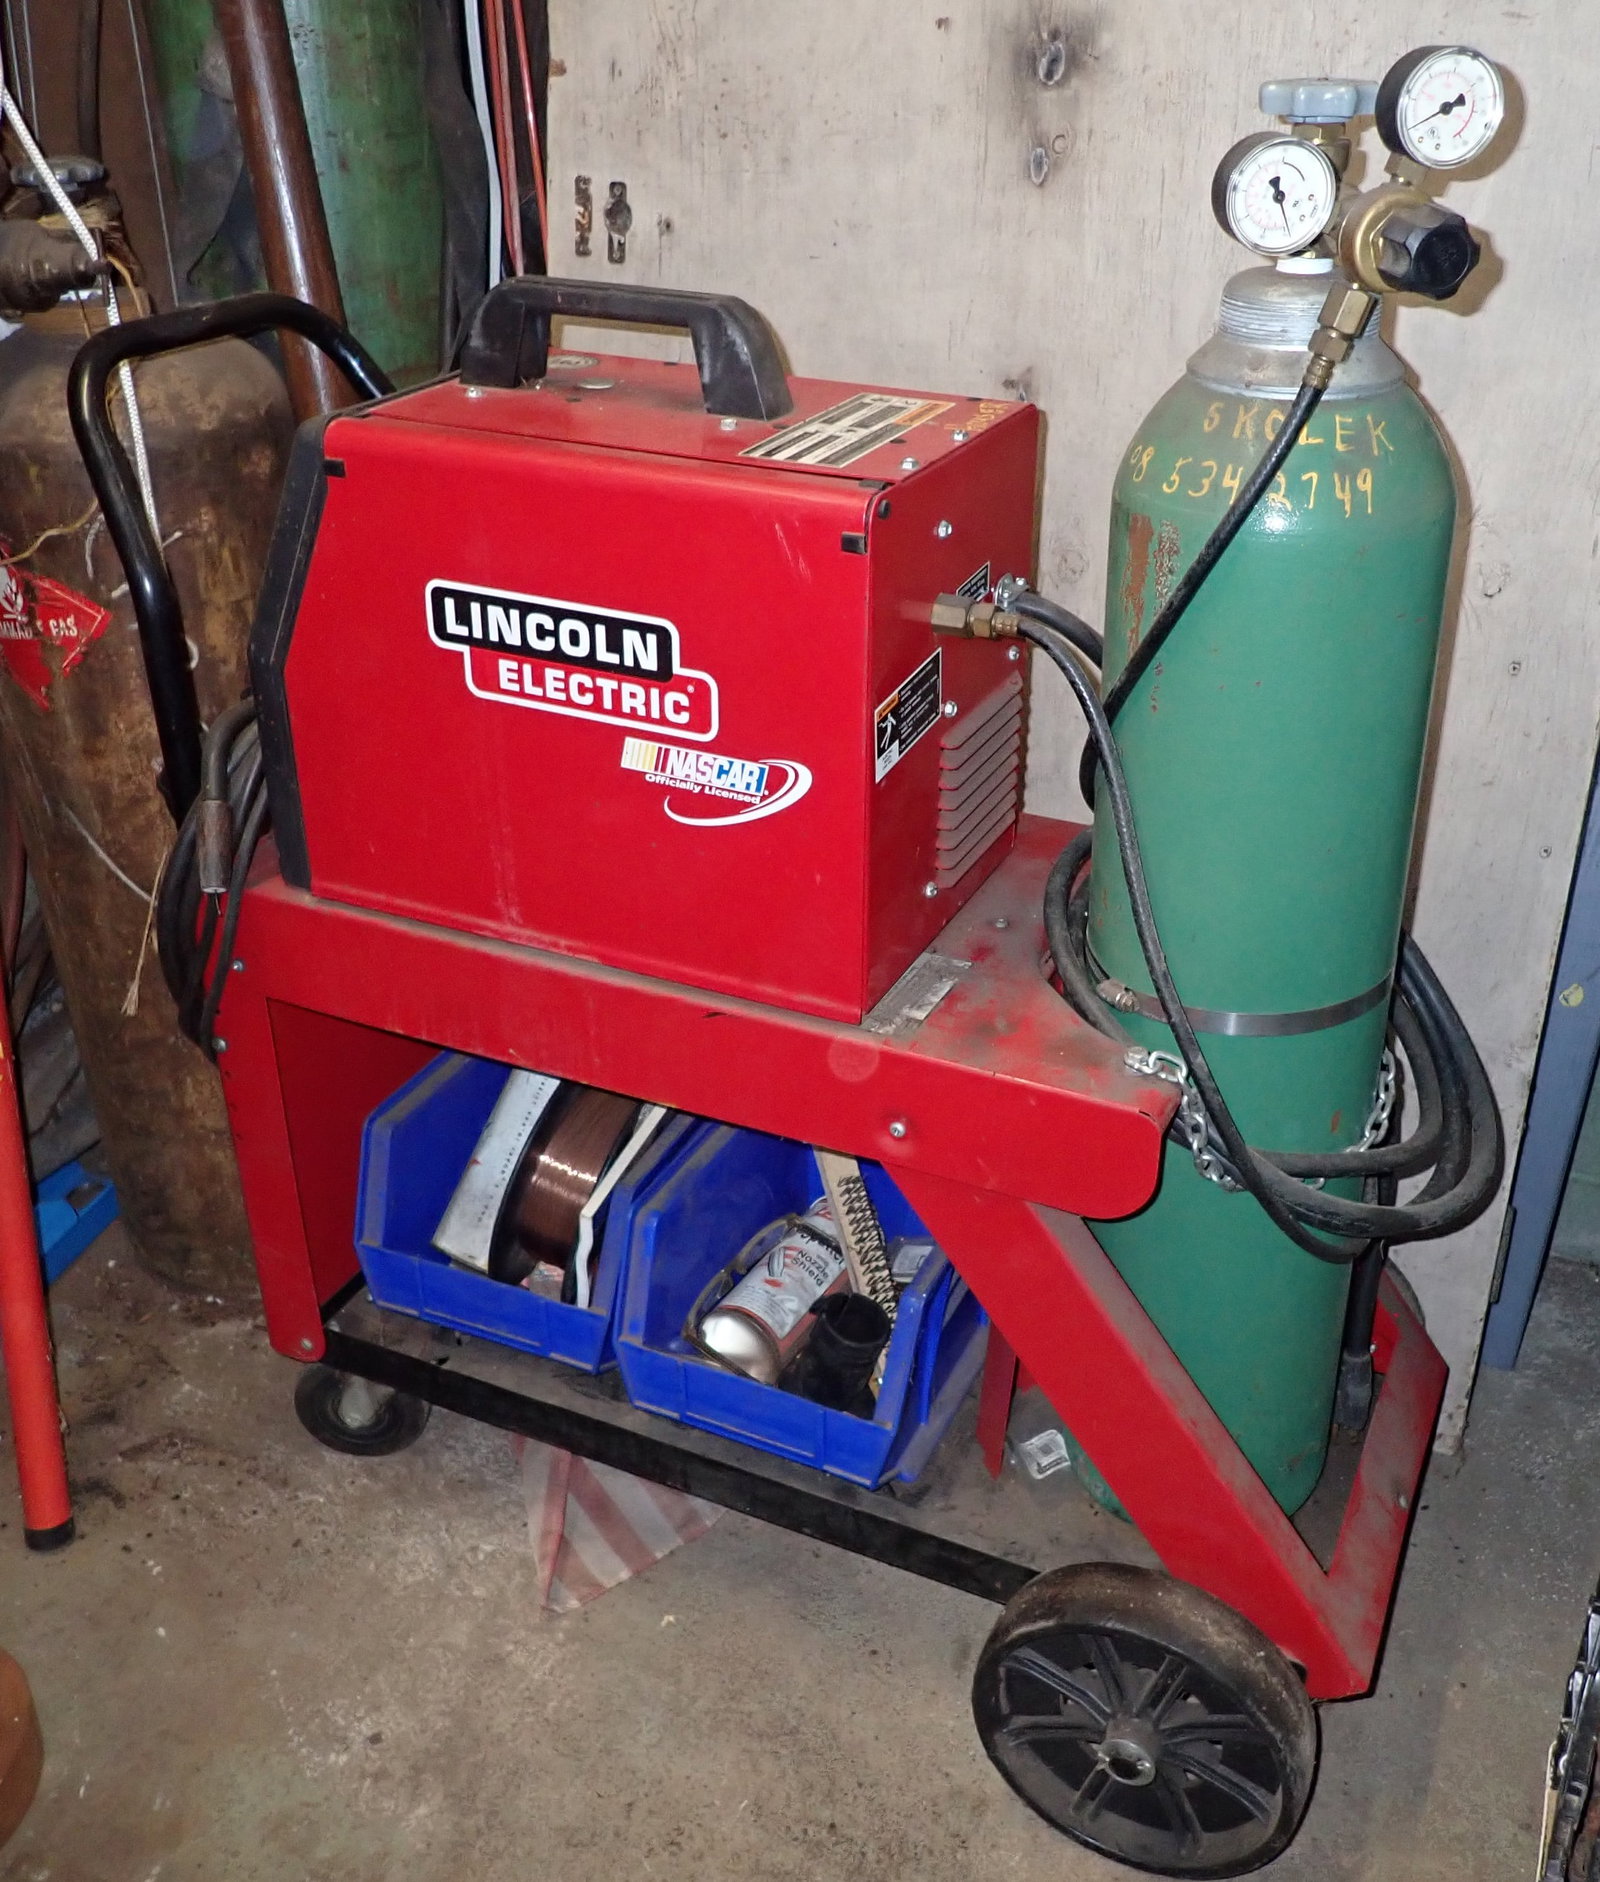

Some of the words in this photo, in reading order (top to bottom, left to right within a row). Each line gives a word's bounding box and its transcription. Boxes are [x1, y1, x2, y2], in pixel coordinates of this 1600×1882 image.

[443, 597, 658, 671] LINCOLN
[498, 659, 690, 724] ELECTRIC
[645, 773, 702, 793] Officially
[704, 786, 761, 804] Licensed
[666, 748, 762, 794] NASCAR
[792, 1257, 825, 1288] Shield
[798, 1250, 828, 1279] Nozzle
